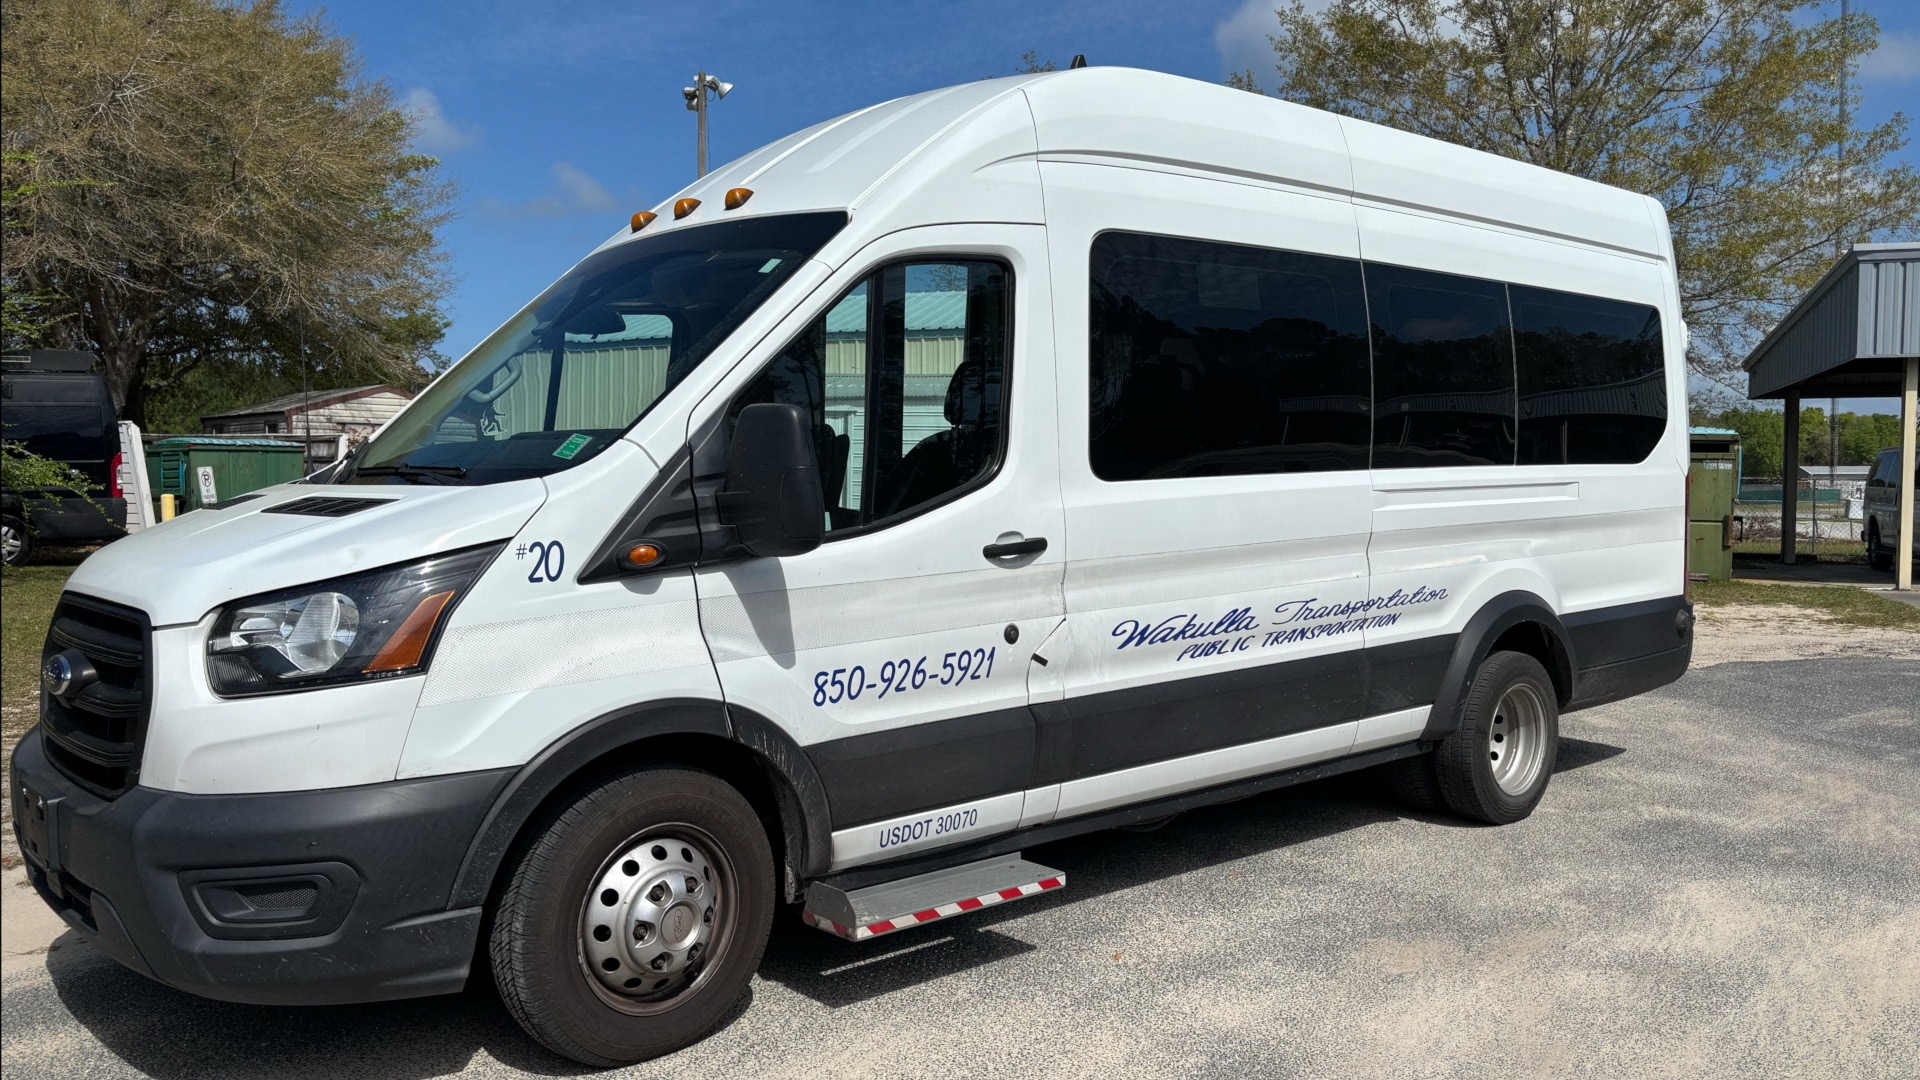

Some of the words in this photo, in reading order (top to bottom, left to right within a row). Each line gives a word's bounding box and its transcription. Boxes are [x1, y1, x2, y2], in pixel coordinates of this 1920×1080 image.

[515, 540, 564, 583] #20
[1111, 607, 1260, 650] Wakulla
[1272, 585, 1448, 625] Transportation
[1176, 635, 1256, 661] PUBLIC
[1262, 612, 1402, 647] TRANSPORTATION
[813, 646, 996, 707] 850-926-5921
[880, 819, 933, 848] USDOT
[935, 809, 977, 834] 30070
